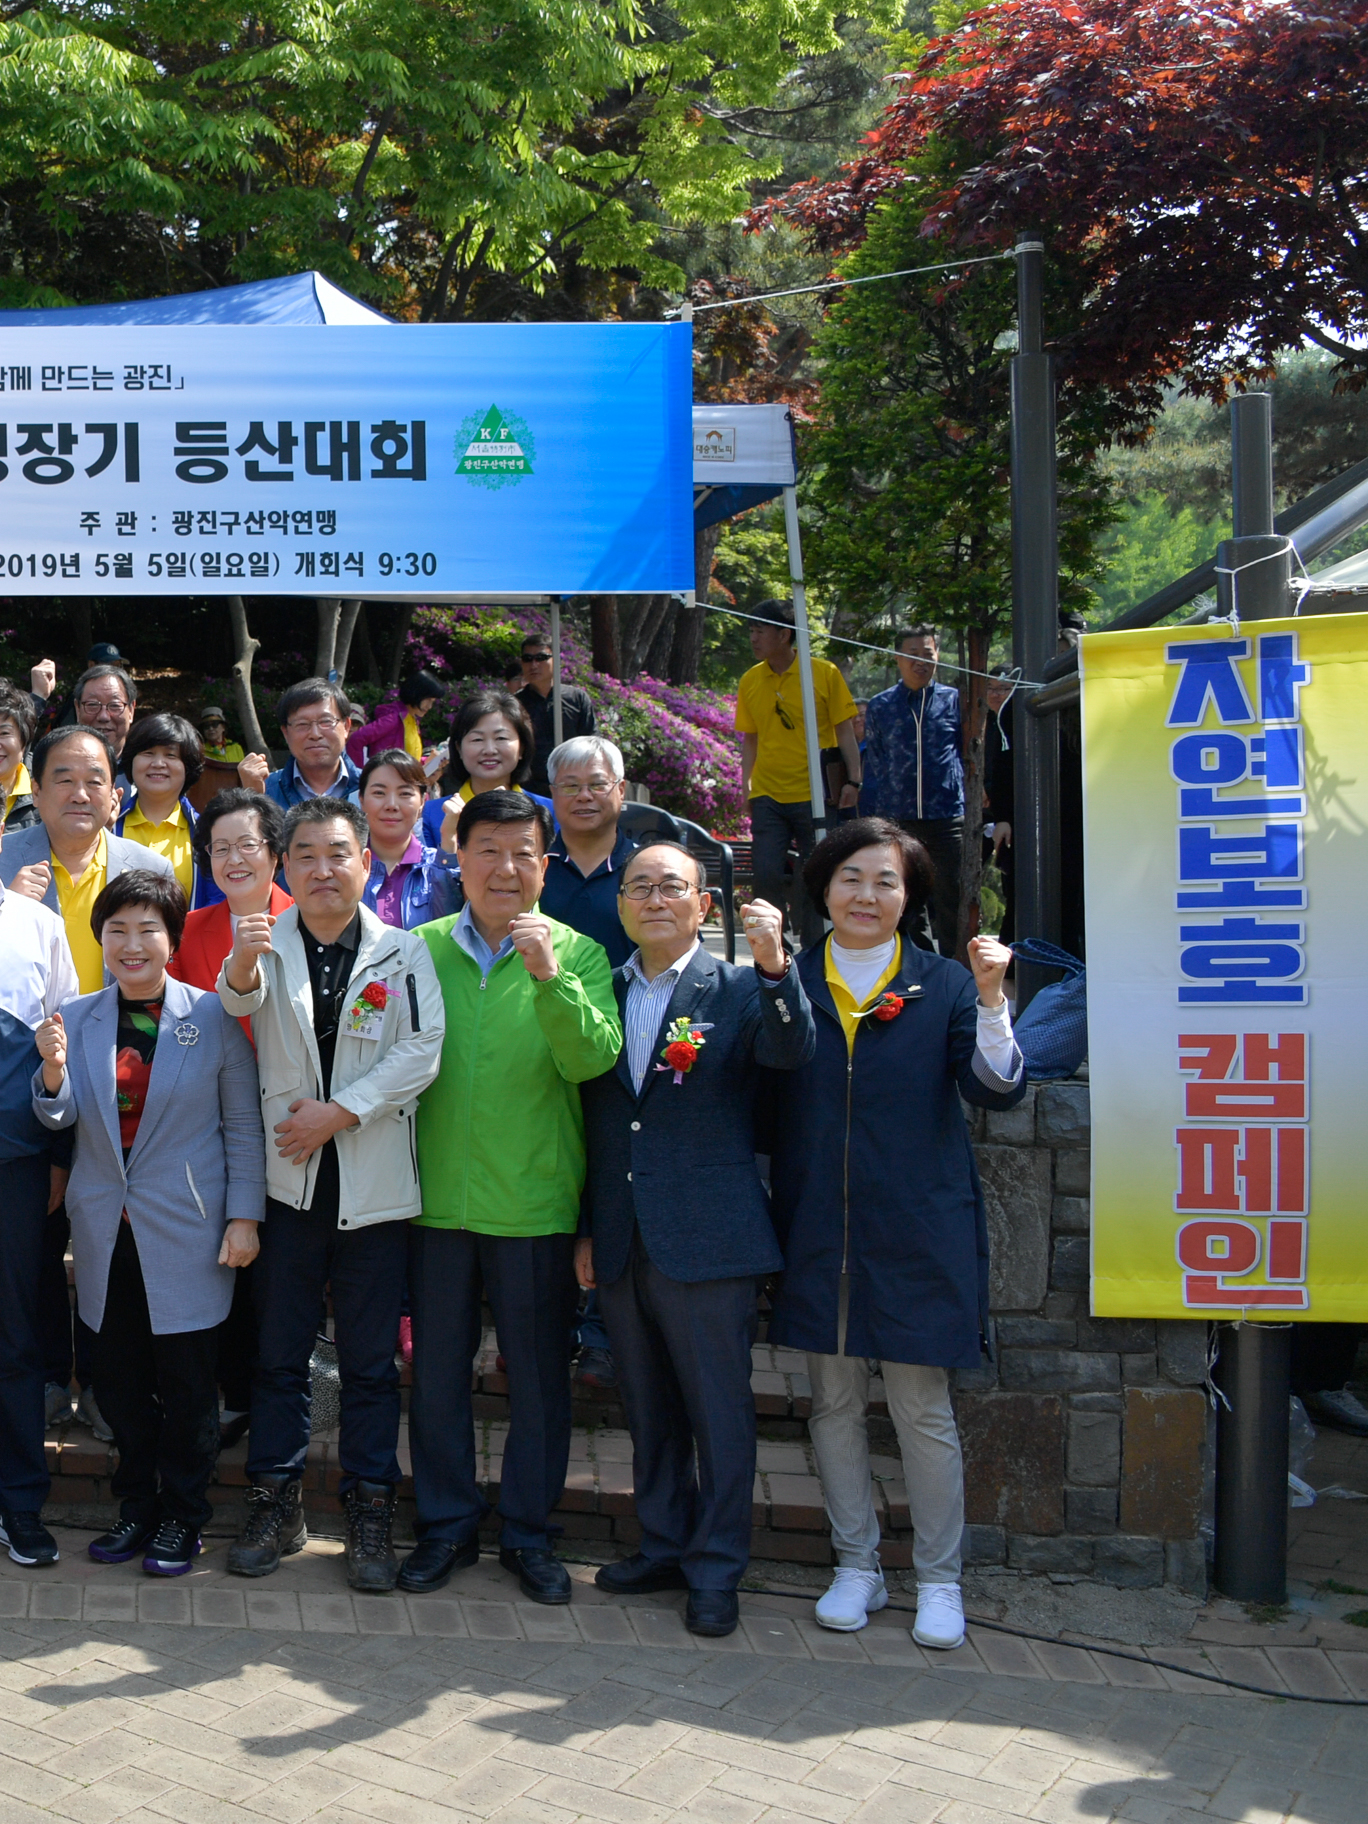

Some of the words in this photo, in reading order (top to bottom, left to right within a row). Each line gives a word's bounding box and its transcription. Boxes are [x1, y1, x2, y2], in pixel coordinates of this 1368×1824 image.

[41, 365, 115, 392] 만드는
[173, 419, 427, 484] 등산대회
[171, 509, 337, 537] 광진구산악연맹
[94, 552, 134, 579] 5월
[147, 551, 280, 578] 5일(일요일)
[294, 551, 364, 578] 개회식
[378, 551, 437, 577] 9:30
[1165, 631, 1311, 1007] 자연보호
[1174, 1031, 1310, 1310] 캠페인
